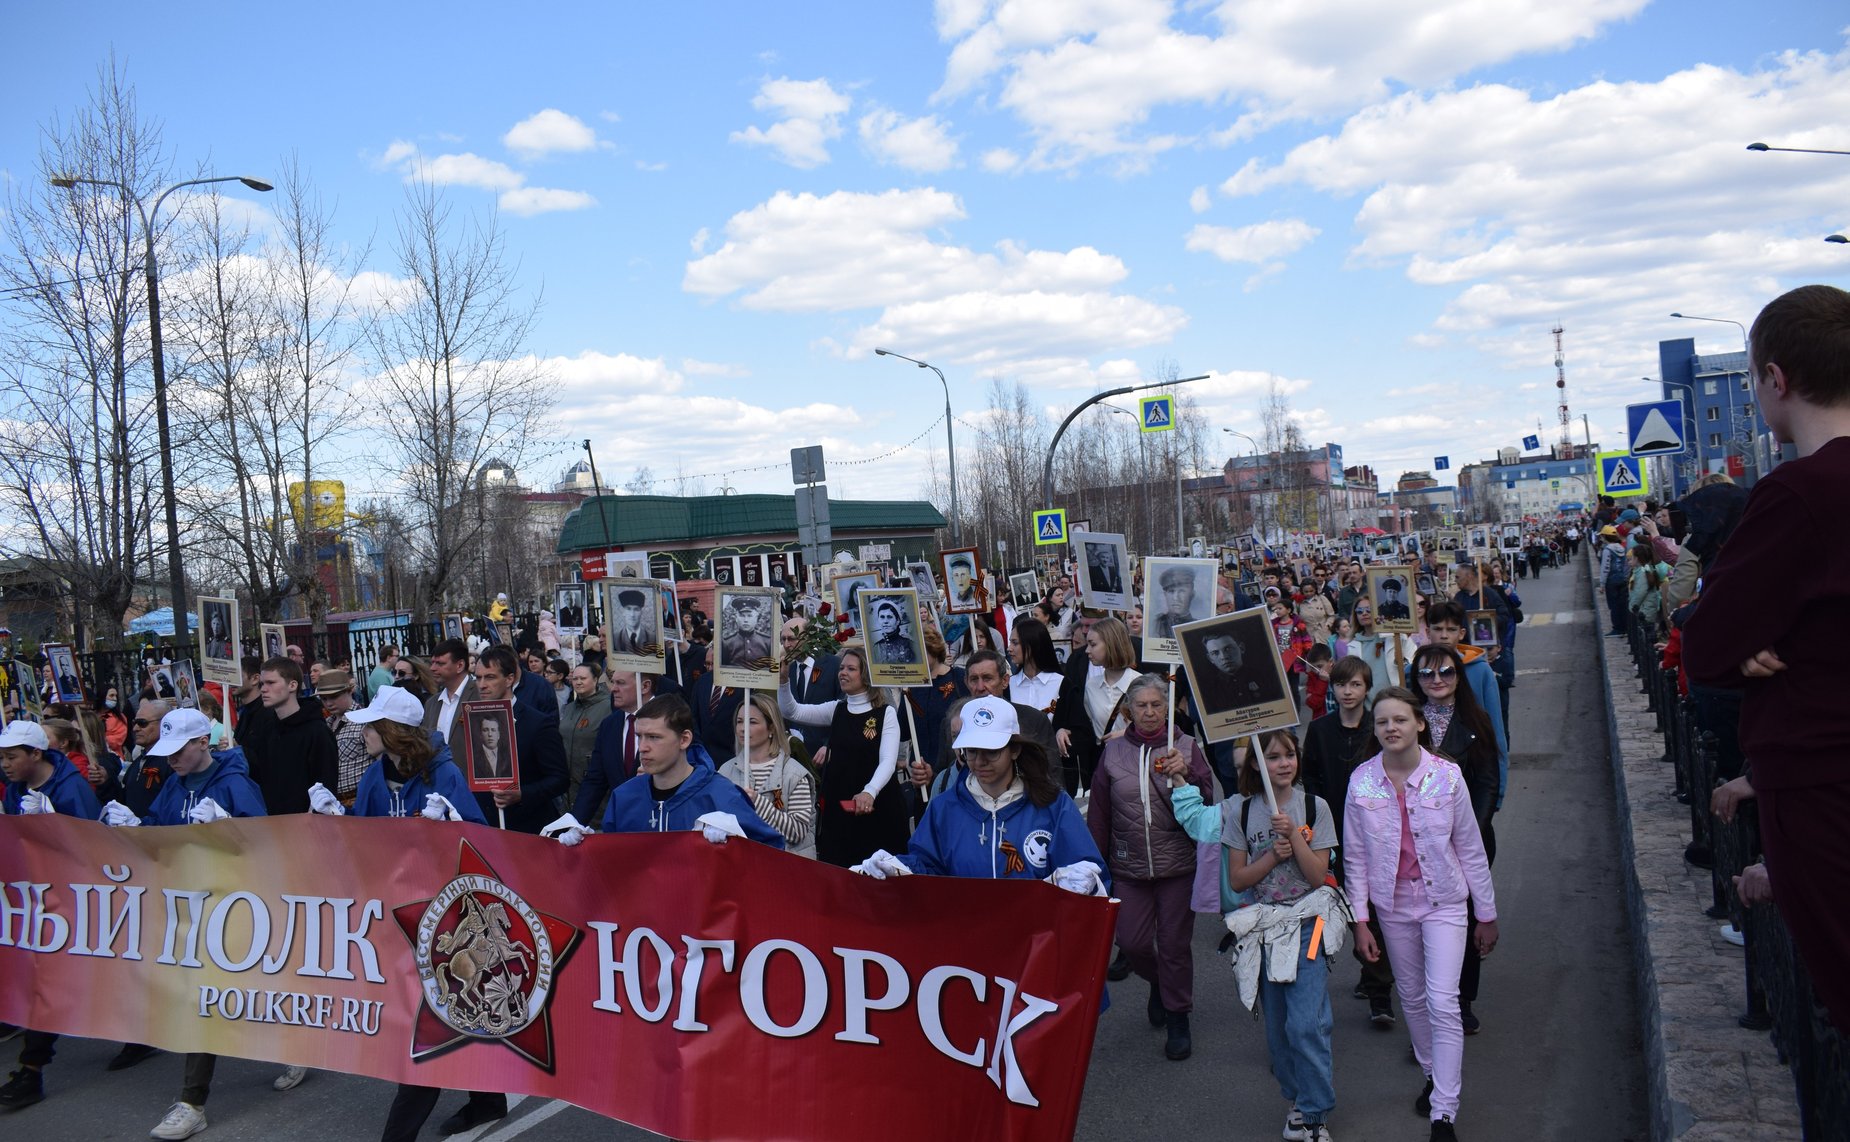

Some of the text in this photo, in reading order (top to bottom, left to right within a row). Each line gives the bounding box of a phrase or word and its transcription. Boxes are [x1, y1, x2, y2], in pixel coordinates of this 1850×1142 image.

[1225, 709, 1274, 723] Василий Петрович
[1236, 707, 1260, 715] Абатуров
[156, 890, 386, 984] ПОЛК
[420, 875, 551, 992] БЕССМЕРТНЫЙ ПОЛК РОССИИ
[198, 985, 384, 1036] POLKRF.RU
[586, 920, 1059, 1107] ЮГОРСК
